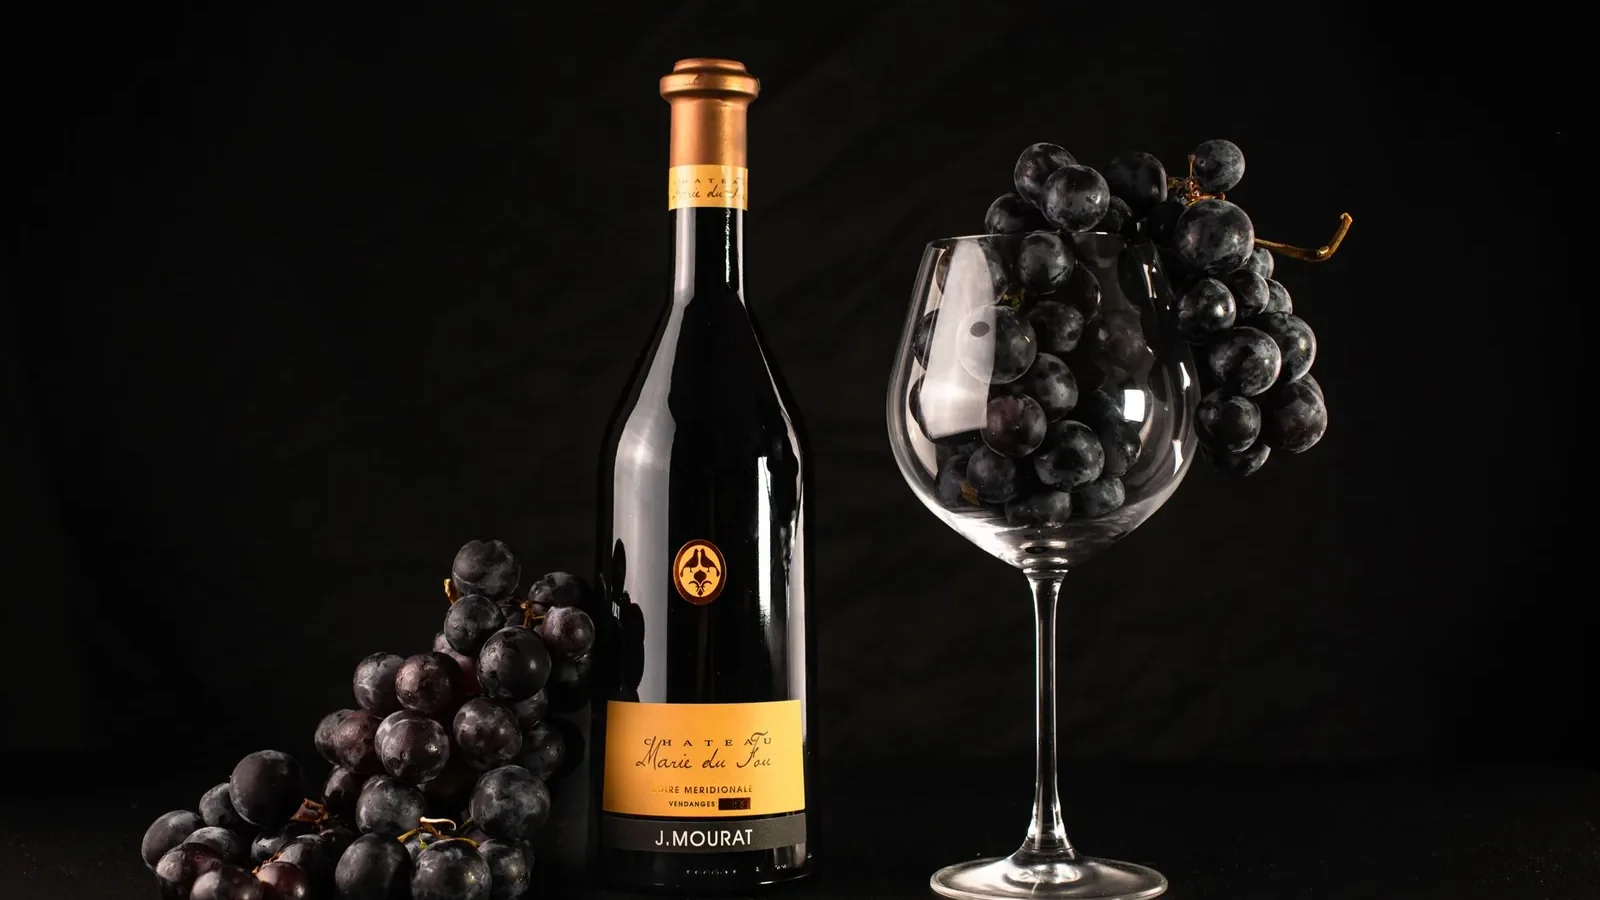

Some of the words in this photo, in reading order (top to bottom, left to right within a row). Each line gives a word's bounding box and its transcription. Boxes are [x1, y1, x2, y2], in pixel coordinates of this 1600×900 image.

[707, 184, 723, 198] du
[643, 738, 772, 746] CHATEAU
[635, 735, 692, 770] Marie
[702, 748, 726, 768] du
[736, 731, 771, 768] Fou
[684, 785, 753, 794] MERIDIONALE
[655, 829, 753, 847] J.MOURAT
